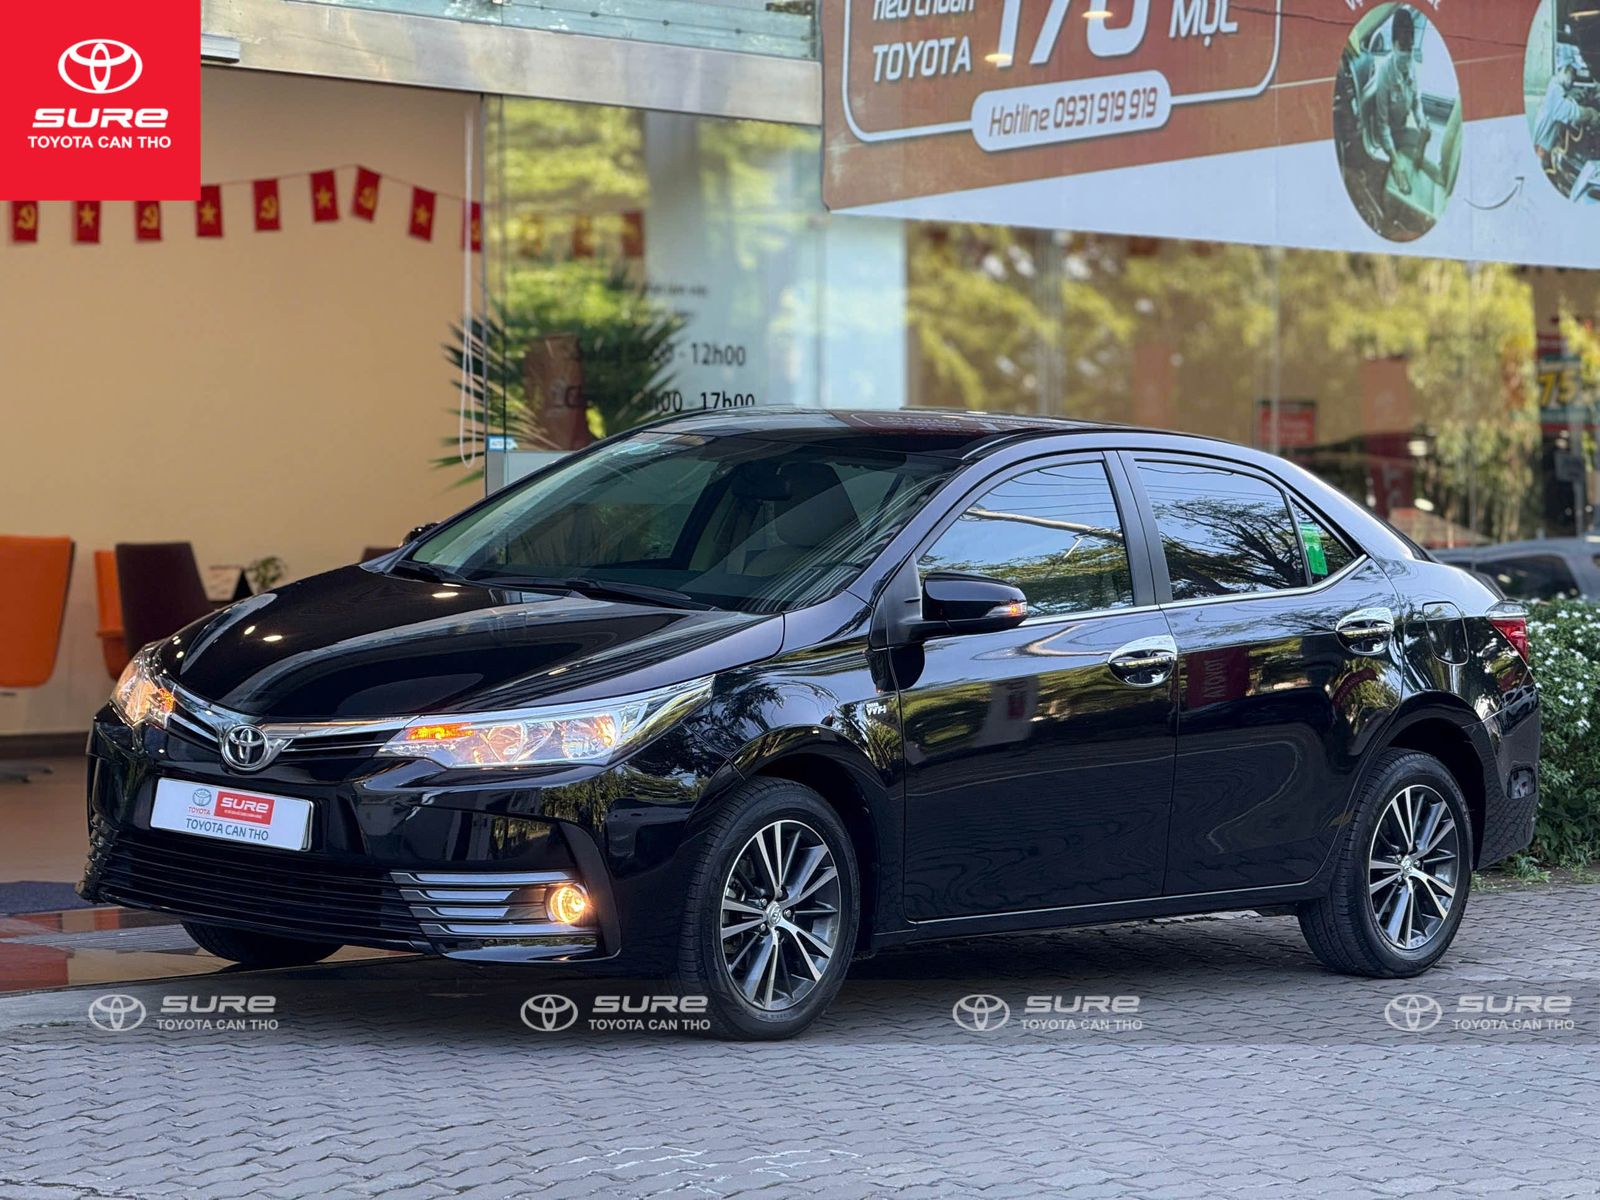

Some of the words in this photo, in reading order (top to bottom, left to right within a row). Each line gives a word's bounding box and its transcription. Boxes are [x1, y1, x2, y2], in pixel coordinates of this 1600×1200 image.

[872, 36, 972, 83] TOYOTA
[988, 102, 1050, 137] Hotline
[1053, 93, 1095, 129] 0931
[1097, 90, 1126, 124] 919
[1129, 86, 1157, 119] 919
[691, 343, 747, 366] 12h00
[186, 818, 223, 835] TOYOTA
[225, 824, 247, 838] CAN
[248, 828, 269, 841] THO
